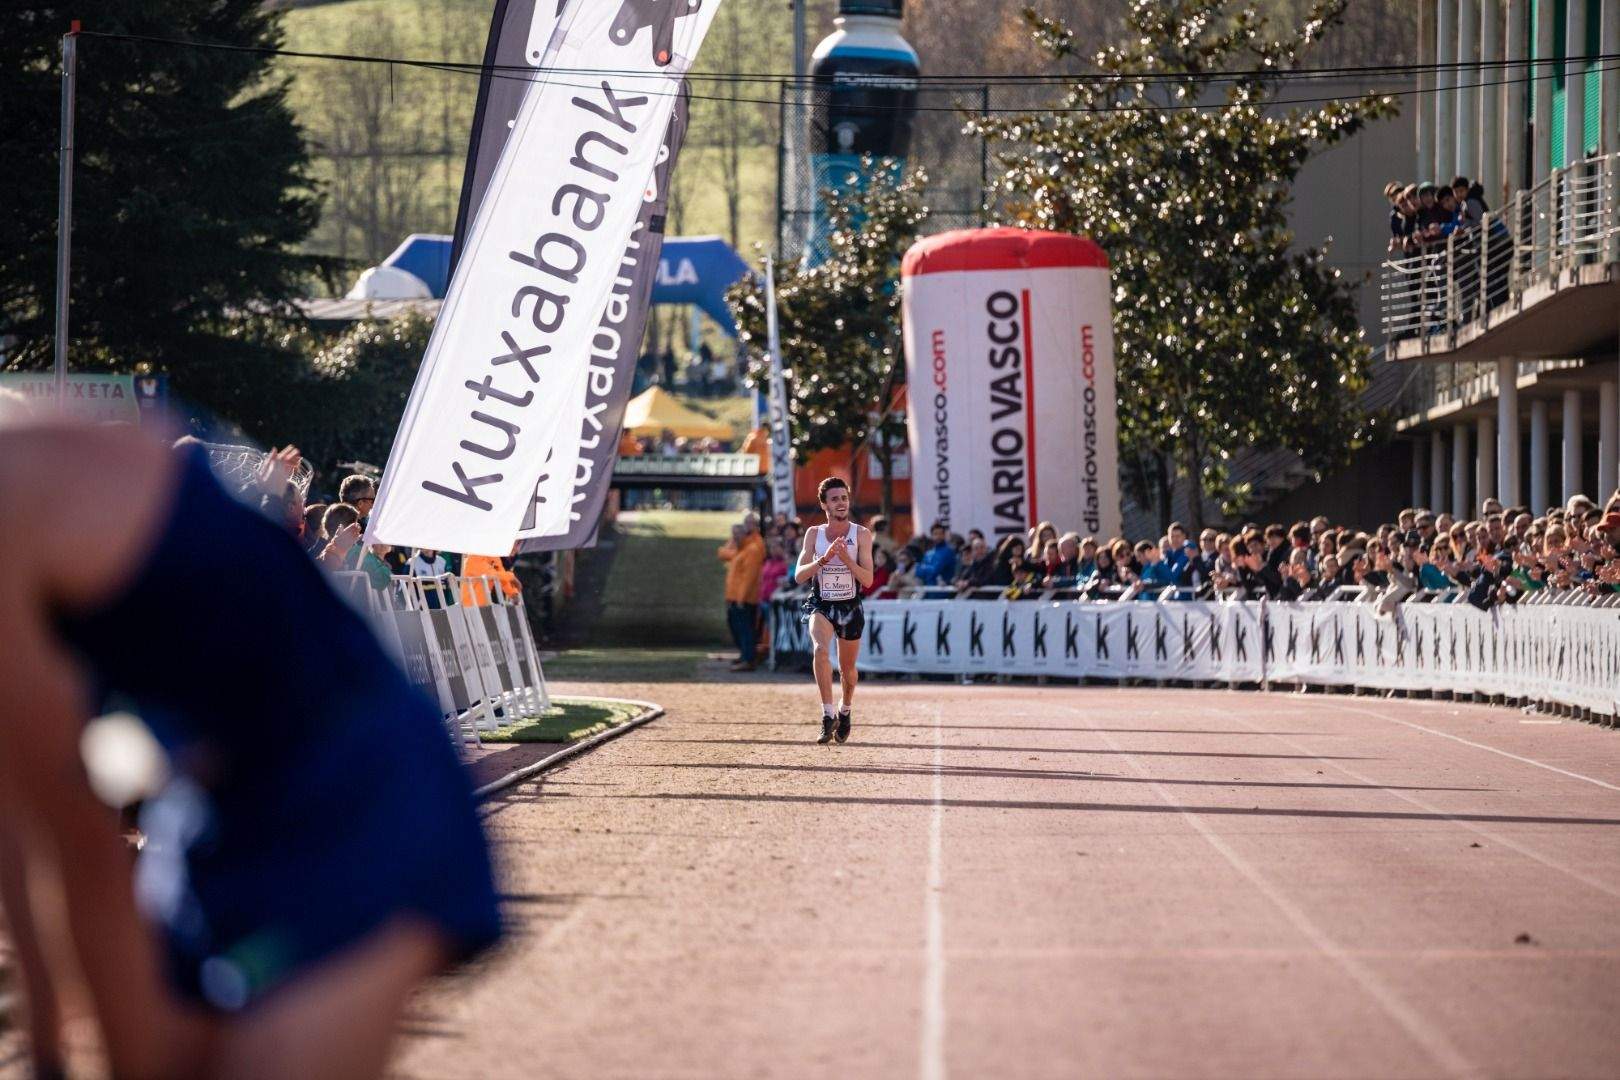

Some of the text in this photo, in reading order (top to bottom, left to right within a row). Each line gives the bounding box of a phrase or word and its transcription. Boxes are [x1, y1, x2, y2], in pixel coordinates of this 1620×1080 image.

[421, 80, 648, 512] kutxabank
[656, 257, 699, 286] LA
[986, 290, 1026, 535] IARIO VASCO
[1080, 324, 1101, 535] diariovasco.com
[832, 582, 850, 590] Mayo
[867, 610, 884, 656] k
[901, 610, 918, 656] k
[936, 610, 951, 657] k
[970, 610, 985, 657] k
[1002, 610, 1016, 658] k
[1033, 611, 1048, 658] k
[1065, 611, 1079, 659] k
[1096, 612, 1109, 660] k
[1127, 612, 1139, 660] k
[1155, 612, 1168, 661] k
[1235, 613, 1248, 663] k
[1286, 614, 1298, 662] k
[1334, 614, 1344, 665] k
